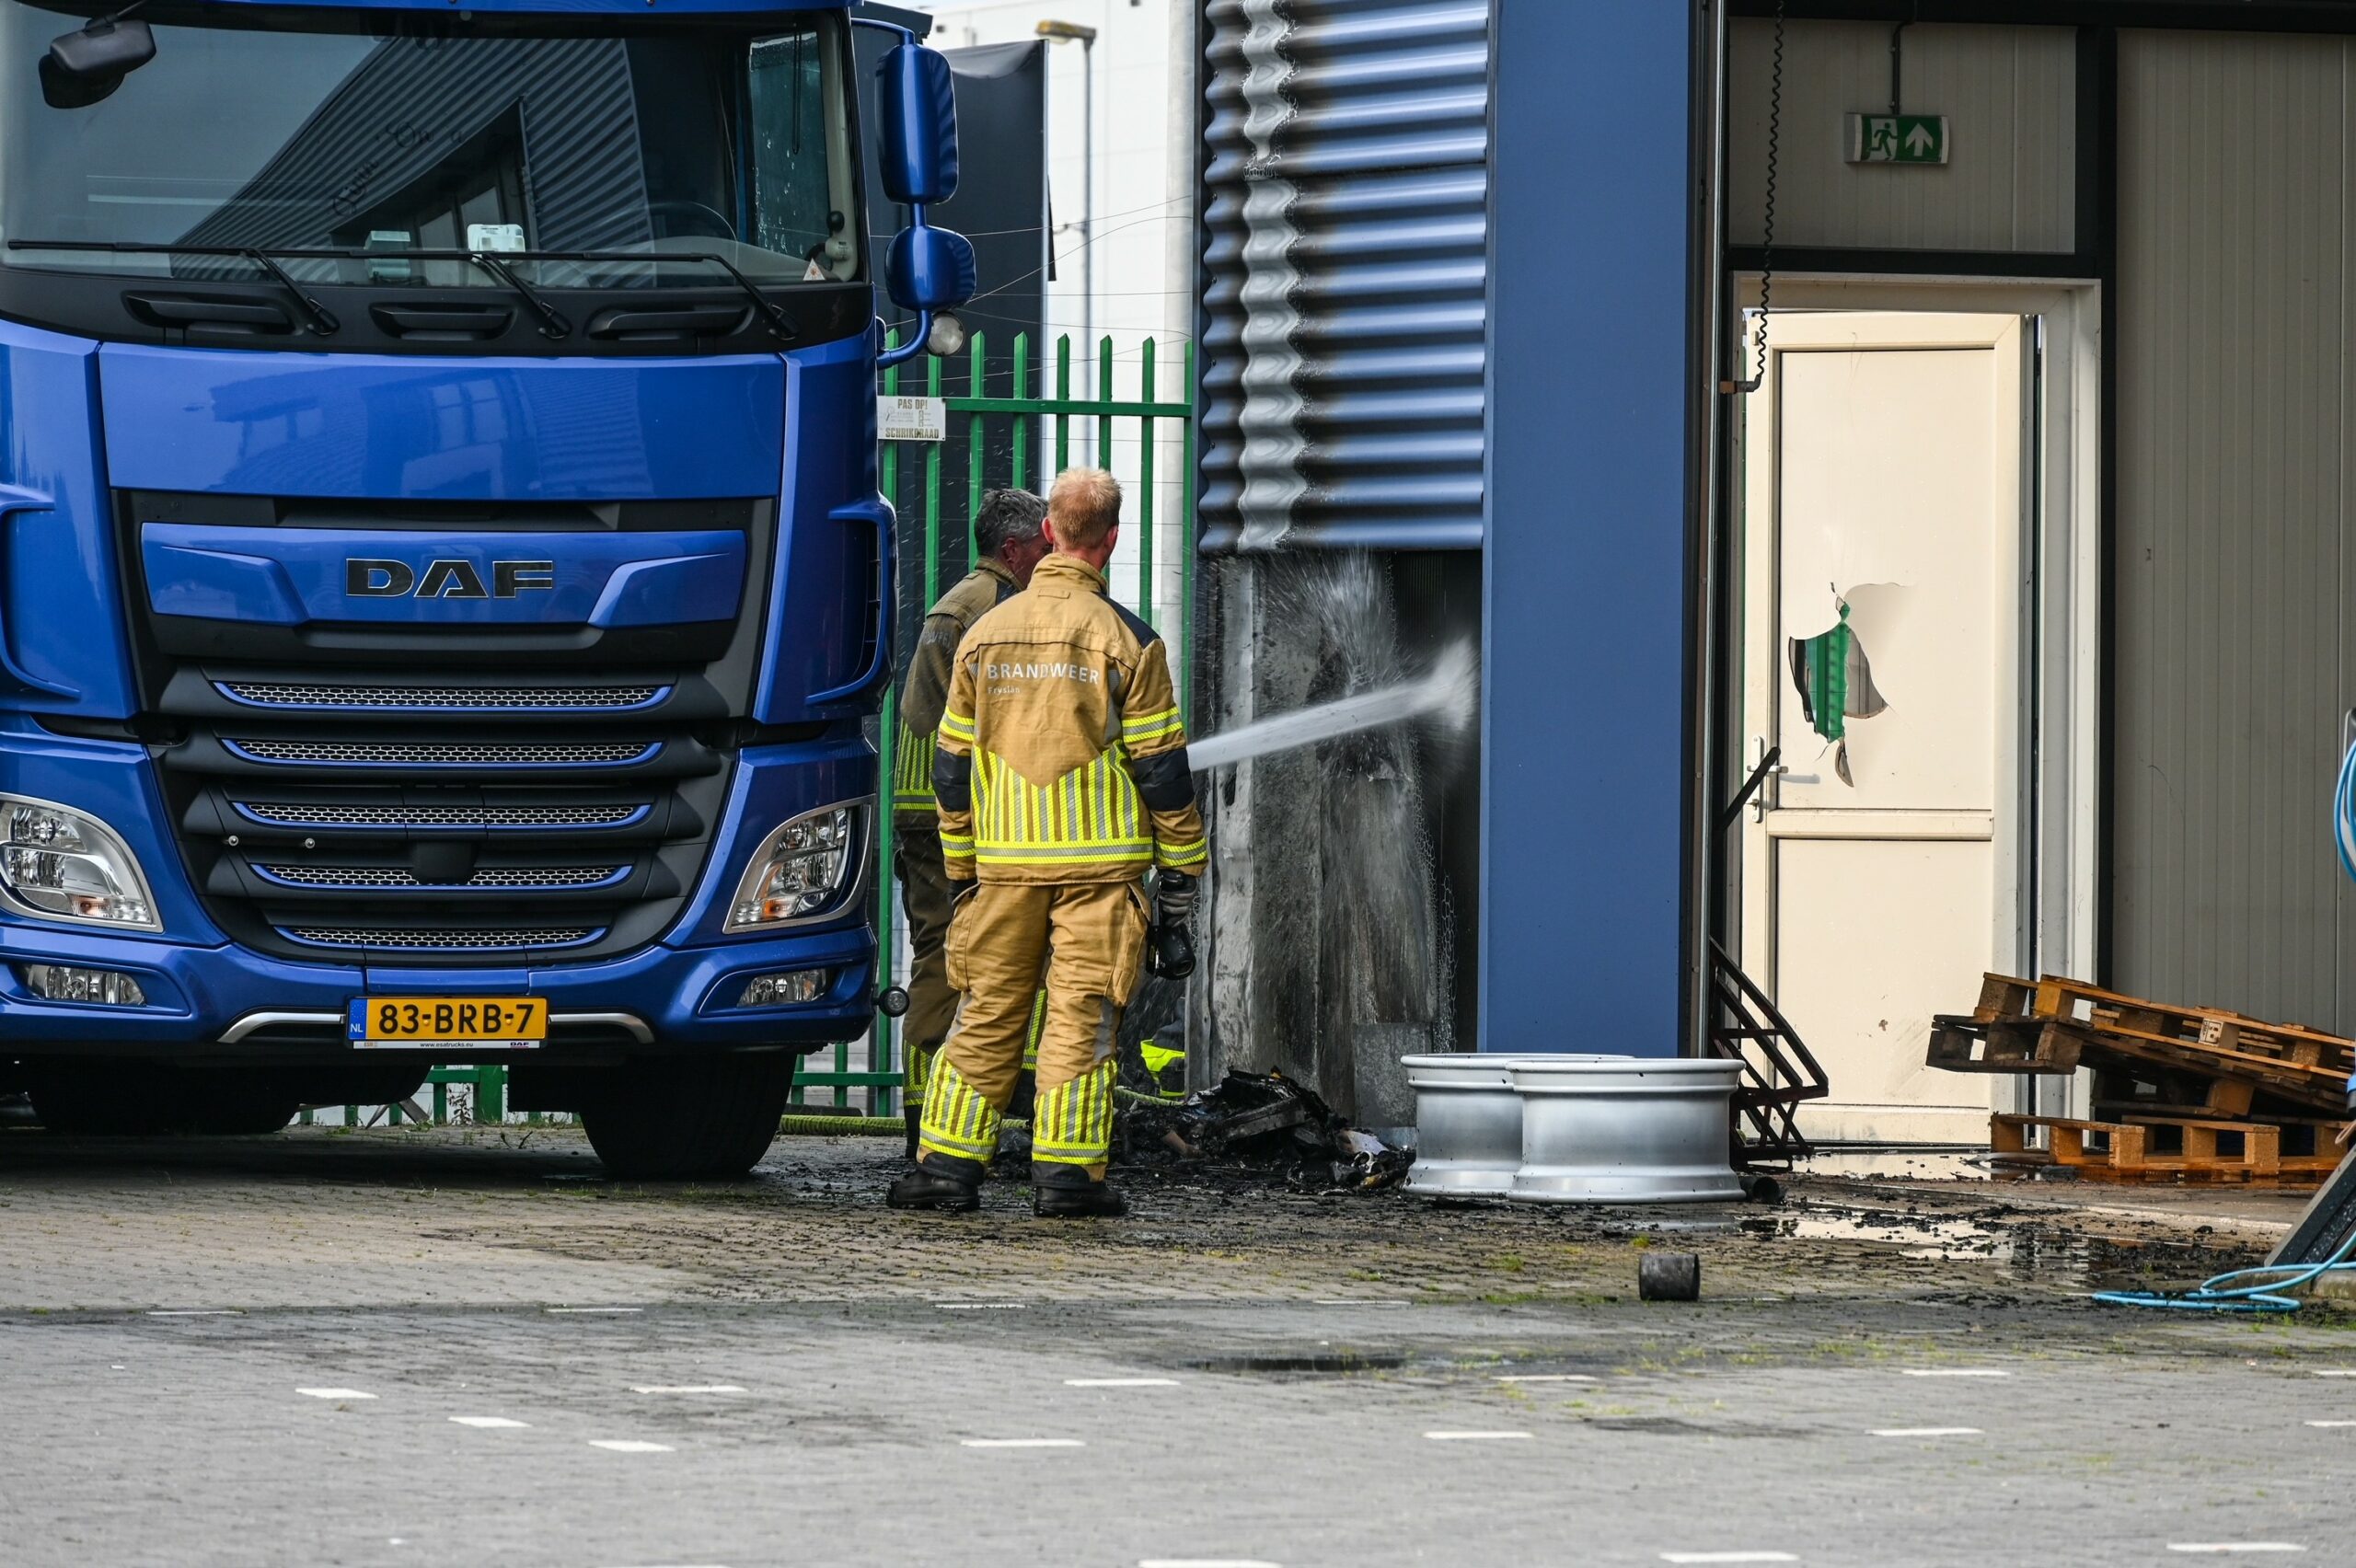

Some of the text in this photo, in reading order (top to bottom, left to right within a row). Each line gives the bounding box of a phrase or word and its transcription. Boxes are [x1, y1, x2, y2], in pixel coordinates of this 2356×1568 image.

[897, 398, 928, 409] PAS OP!
[884, 427, 940, 439] SCHRIKDRAAD
[345, 558, 553, 598] DAF
[987, 663, 1100, 685] BRANDWEER
[378, 1003, 535, 1034] 83-BRB-7
[350, 1023, 364, 1033] NL
